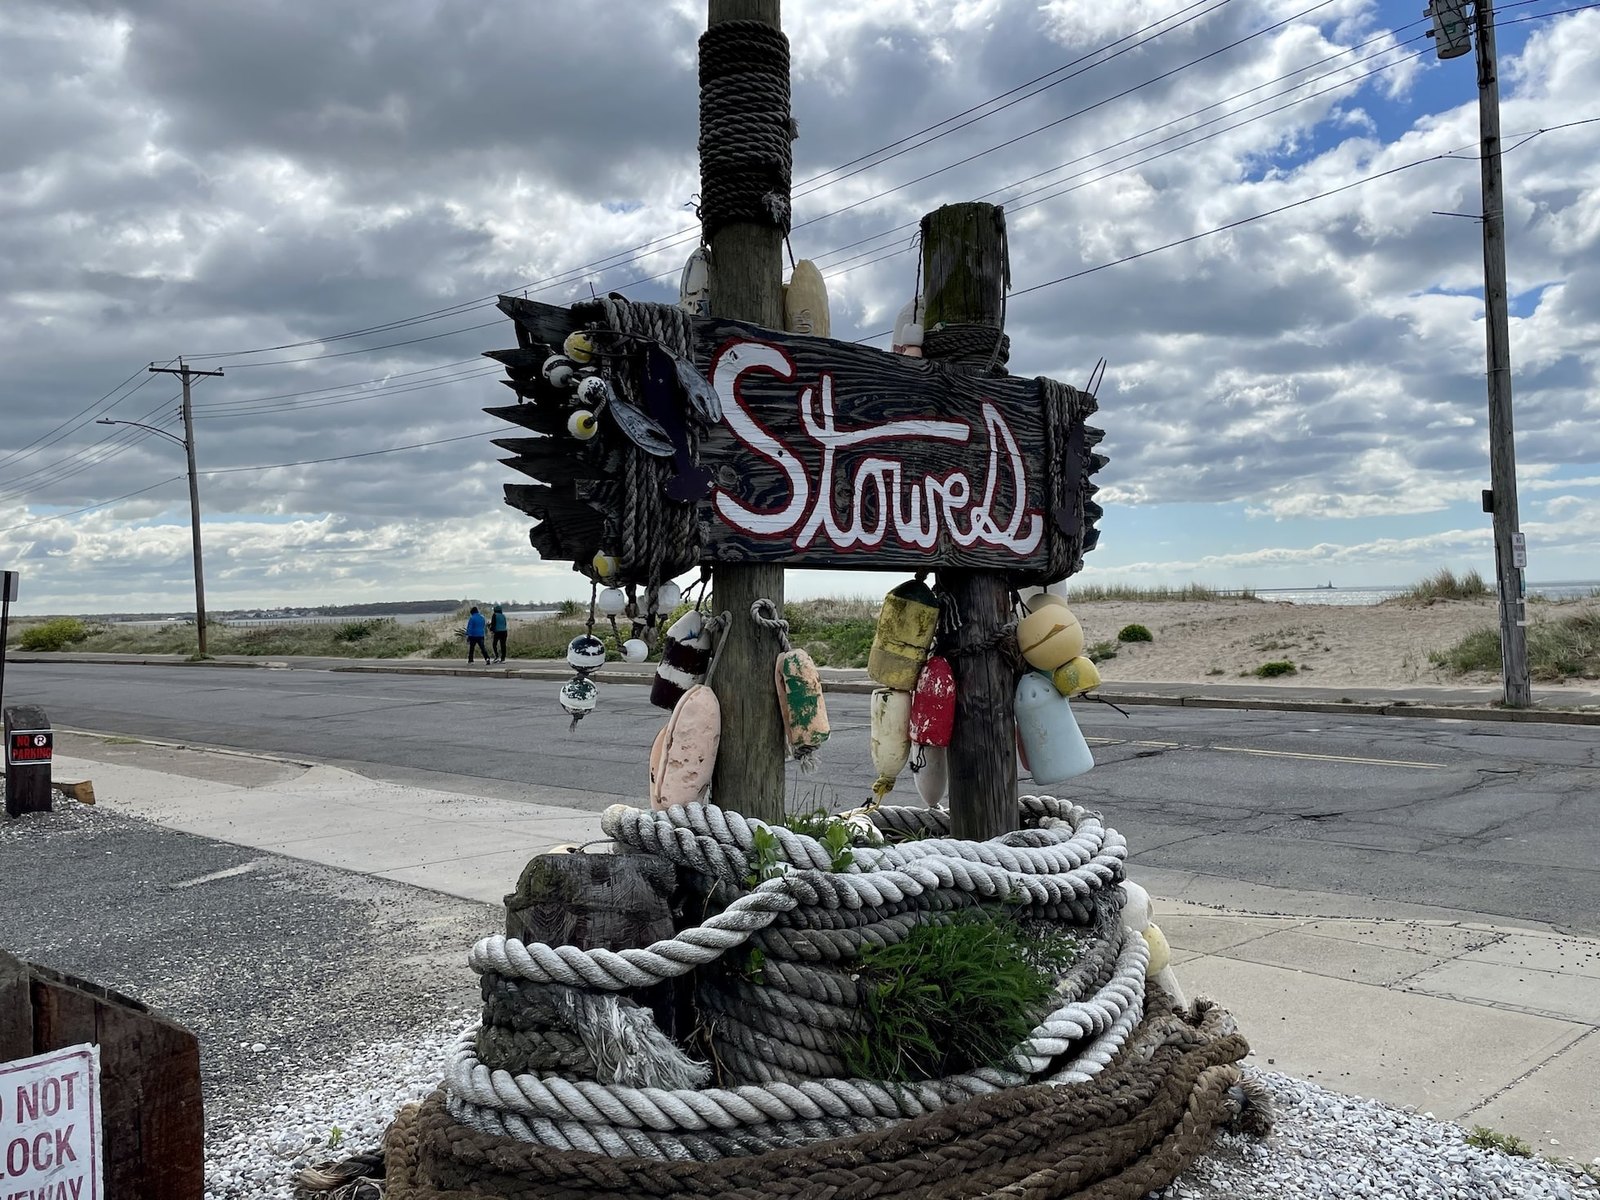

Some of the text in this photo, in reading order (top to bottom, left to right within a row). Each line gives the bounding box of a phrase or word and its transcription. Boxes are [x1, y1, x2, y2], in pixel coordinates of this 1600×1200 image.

[12, 748, 52, 759] PARKING
[16, 735, 29, 746] NO
[17, 1071, 79, 1124] NOT
[0, 1123, 77, 1180] OCK
